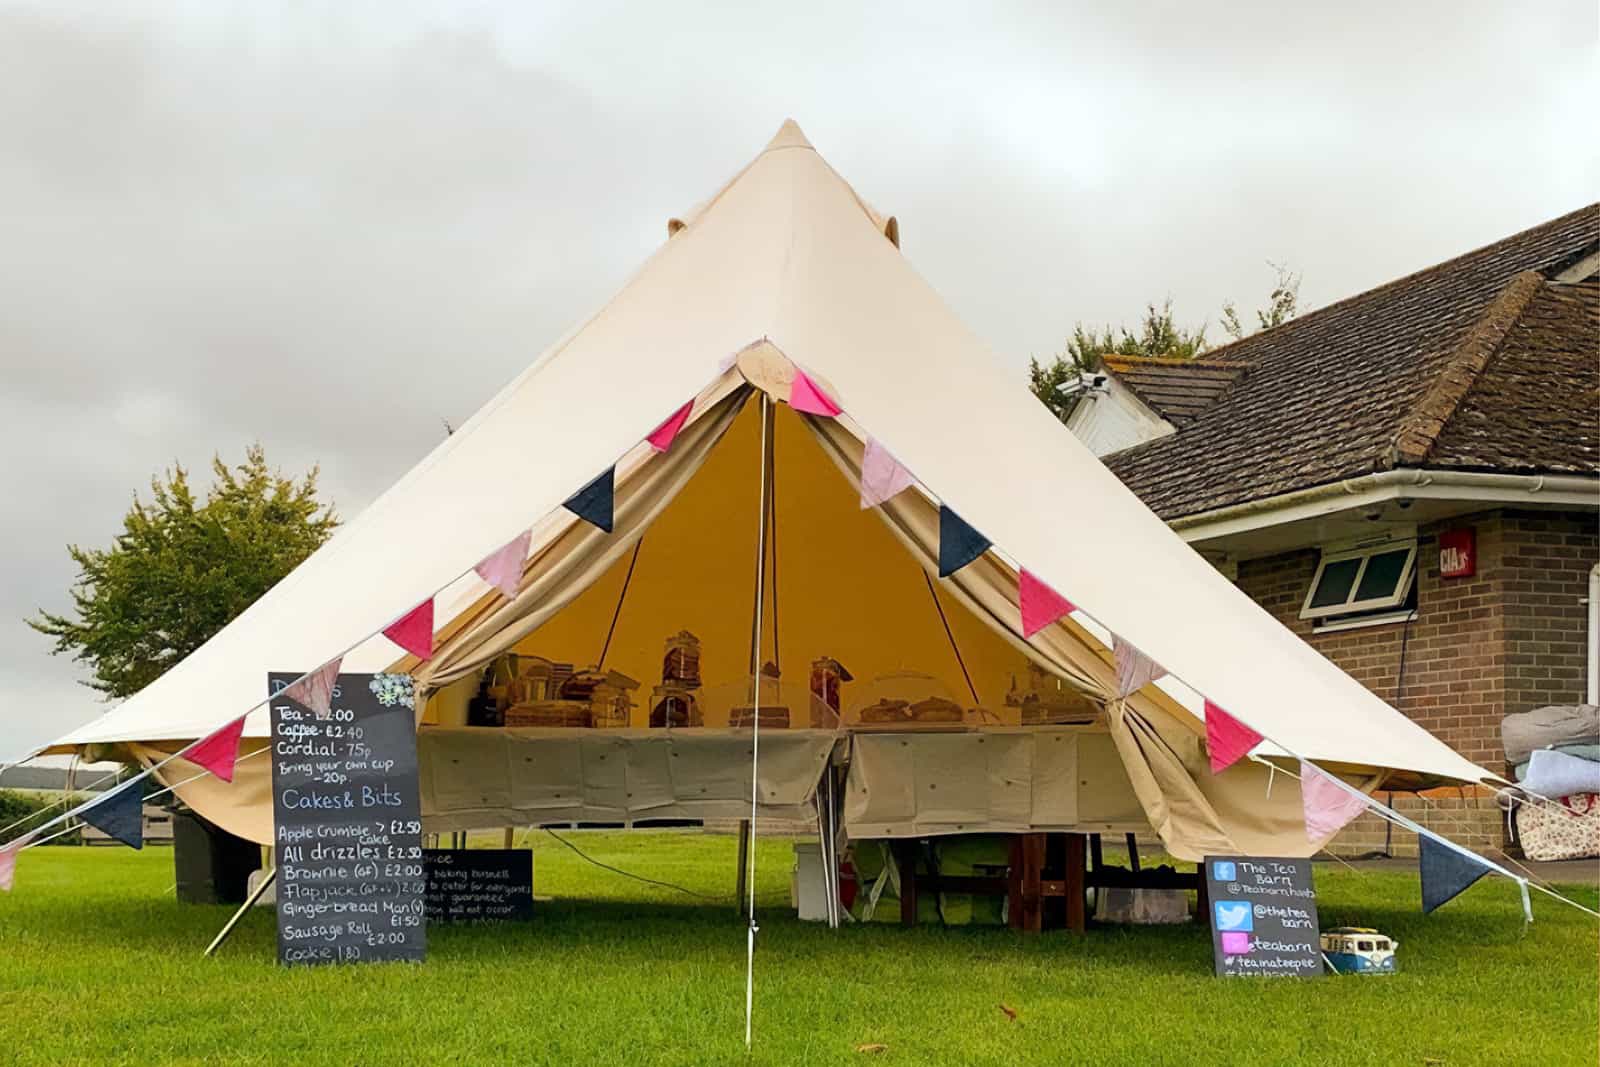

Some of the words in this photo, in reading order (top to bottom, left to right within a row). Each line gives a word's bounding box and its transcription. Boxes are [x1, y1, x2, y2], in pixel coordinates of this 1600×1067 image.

[274, 706, 304, 721] Tea
[276, 739, 337, 757] Cordial
[278, 761, 313, 777] Bring
[315, 760, 342, 773] your
[345, 760, 367, 770] own
[371, 759, 394, 773] cup
[361, 783, 402, 808] Bits
[278, 825, 314, 843] Apple
[316, 824, 370, 839] Crumble
[390, 819, 422, 836] £2.50
[283, 845, 304, 864] All
[310, 841, 380, 861] drizzles
[387, 845, 422, 860] £2.50
[283, 864, 348, 881] Brownie
[1238, 862, 1267, 874] The
[1269, 862, 1297, 874] Tea
[1255, 874, 1292, 887] Barn
[283, 882, 357, 901] Flapjack
[282, 902, 379, 919] Gingerbread
[282, 924, 344, 942] Sausage
[347, 920, 373, 936] Roll
[1280, 918, 1313, 929] barn
[284, 945, 333, 962] Cookie
